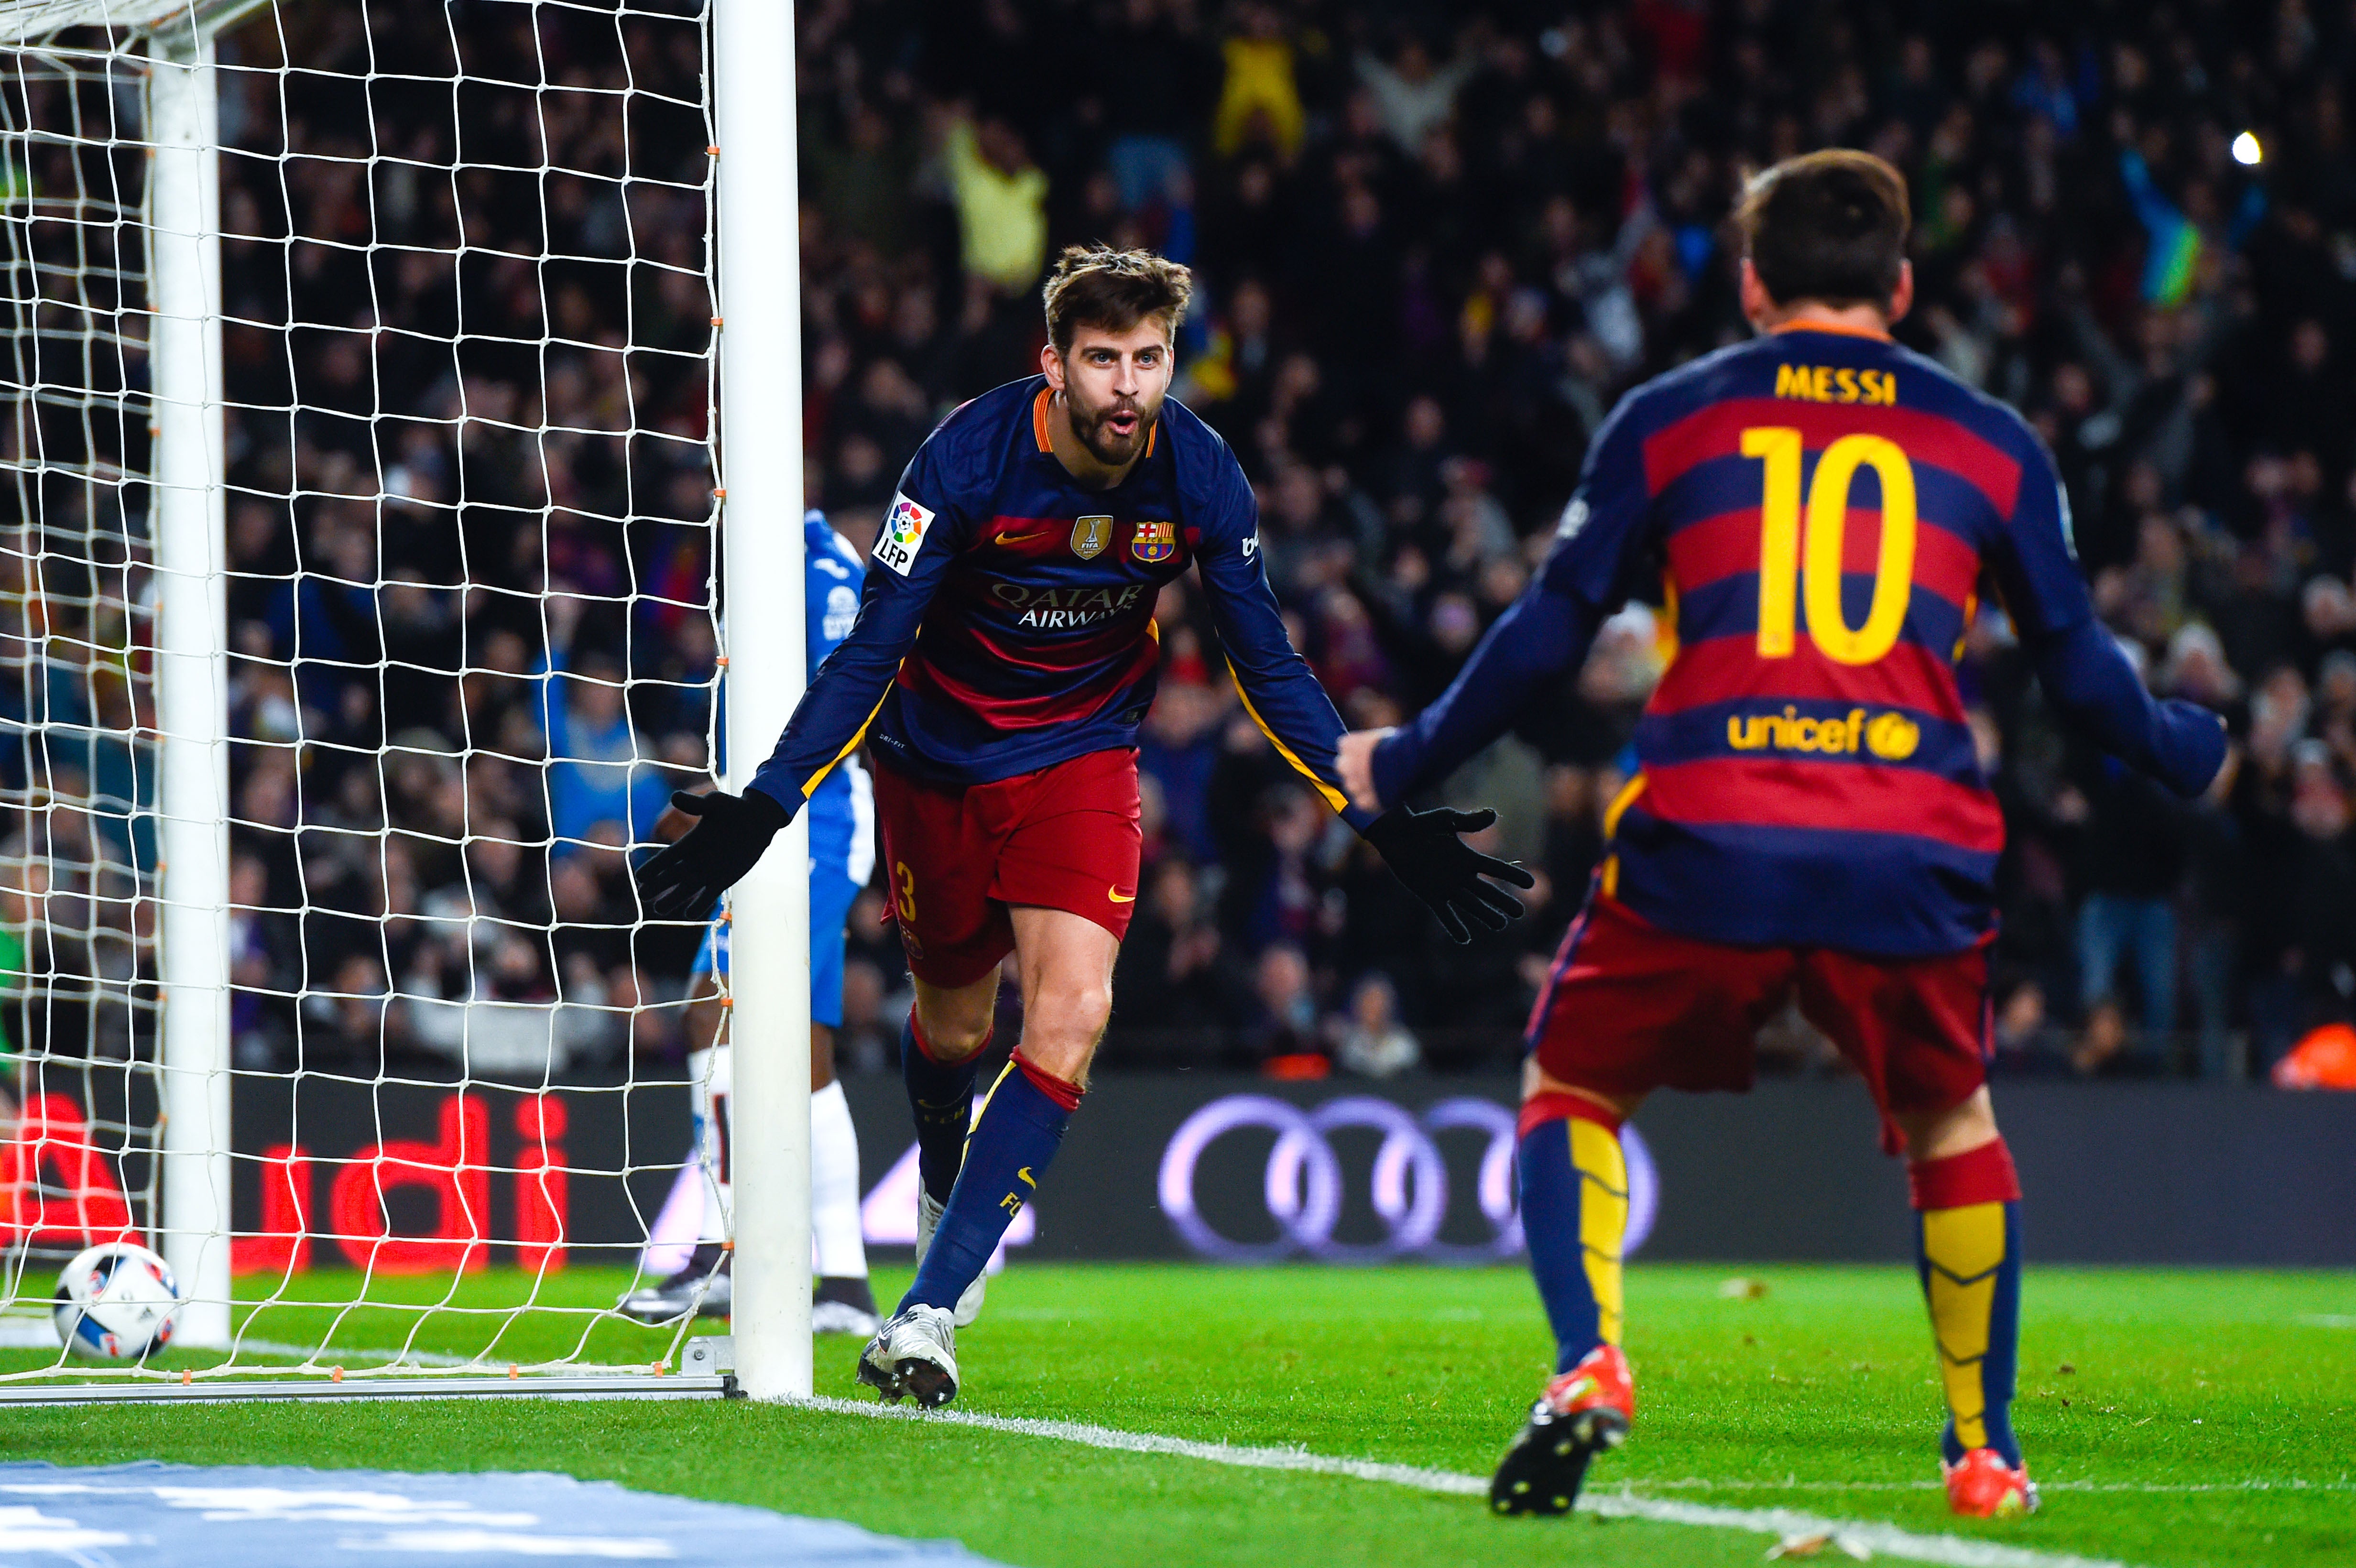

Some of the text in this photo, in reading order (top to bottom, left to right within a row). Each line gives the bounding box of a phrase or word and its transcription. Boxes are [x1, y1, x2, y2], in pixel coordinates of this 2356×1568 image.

[1776, 363, 1896, 406] MESSI
[878, 537, 908, 568] LFP
[1740, 426, 1917, 665] 10
[992, 583, 1144, 608] QATAR
[879, 734, 905, 748] DRI-FIT
[1727, 706, 1865, 754] unicef
[896, 861, 916, 922] 3
